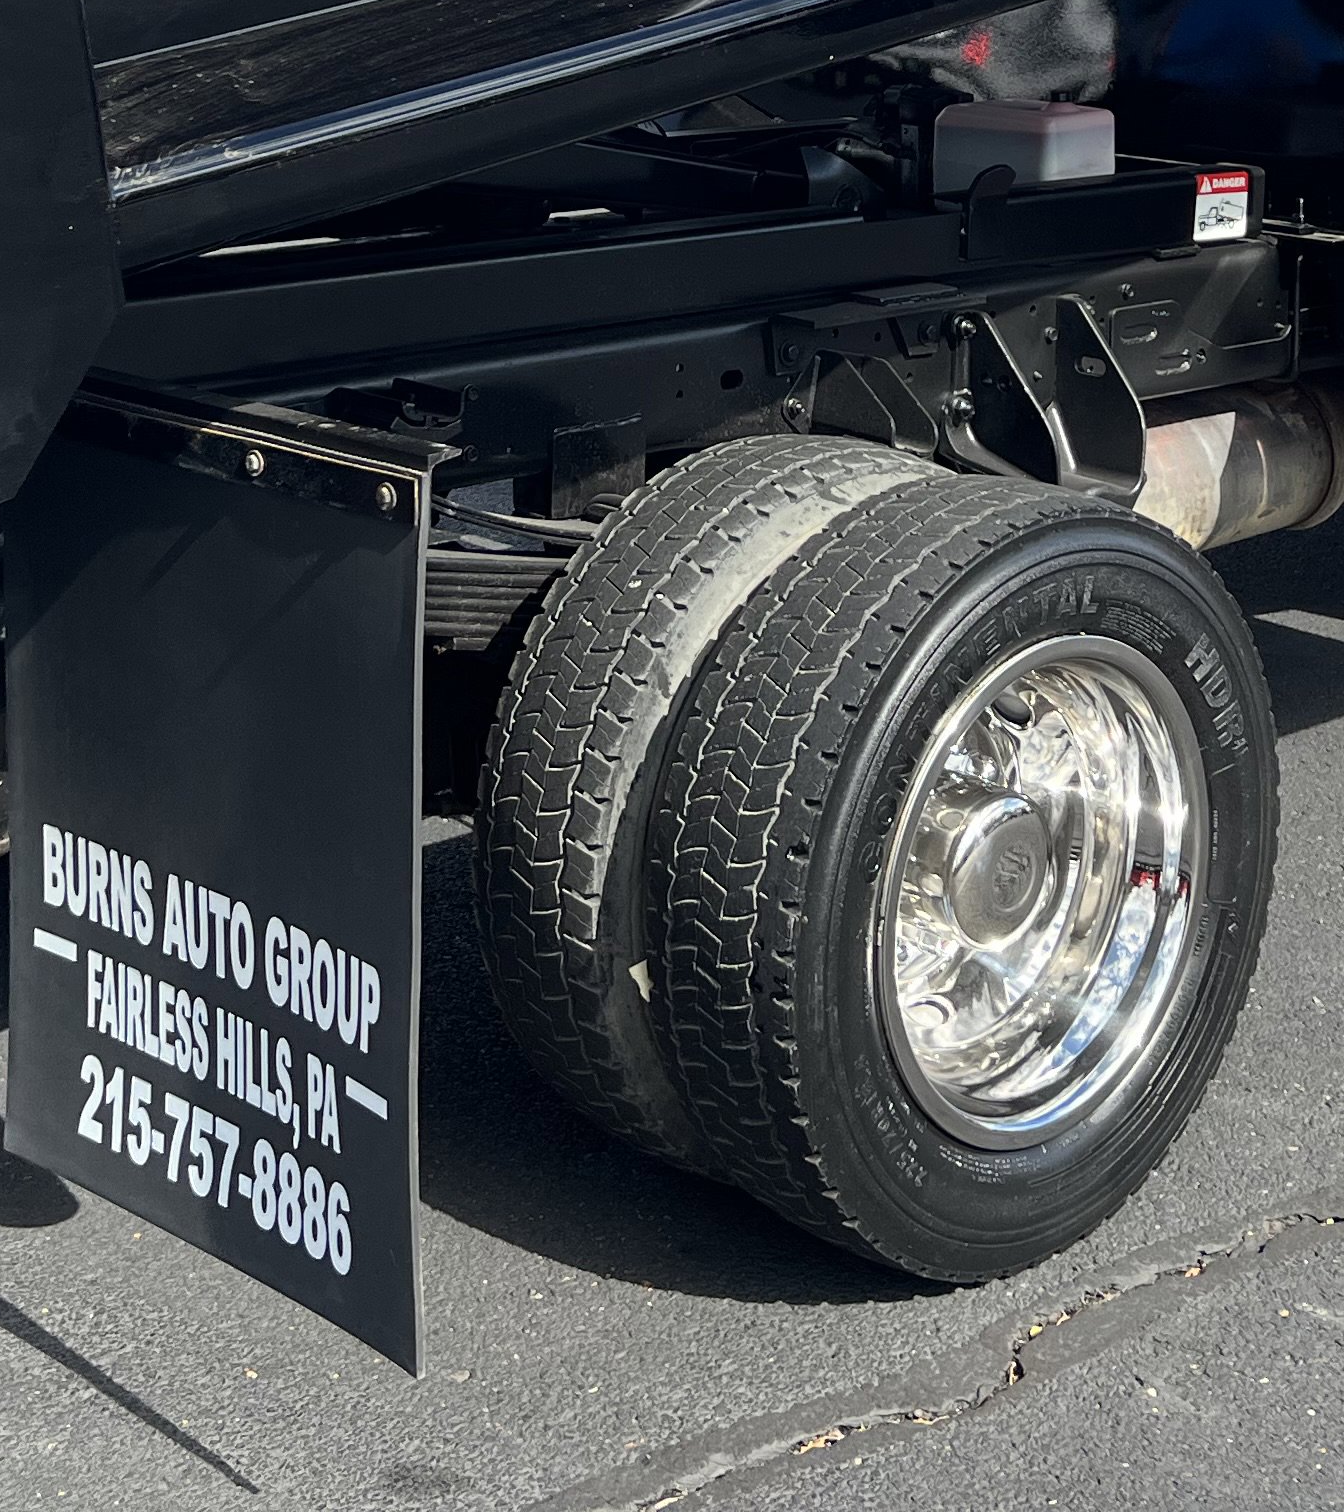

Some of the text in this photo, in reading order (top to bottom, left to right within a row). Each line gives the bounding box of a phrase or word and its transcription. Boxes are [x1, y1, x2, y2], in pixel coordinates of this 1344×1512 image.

[1212, 176, 1247, 189] DANGER
[43, 824, 381, 1054] BURNS AUTO GROUP
[86, 949, 342, 1155] FAIRLESS HILLS, PA
[77, 1054, 353, 1276] 215-757-8886
